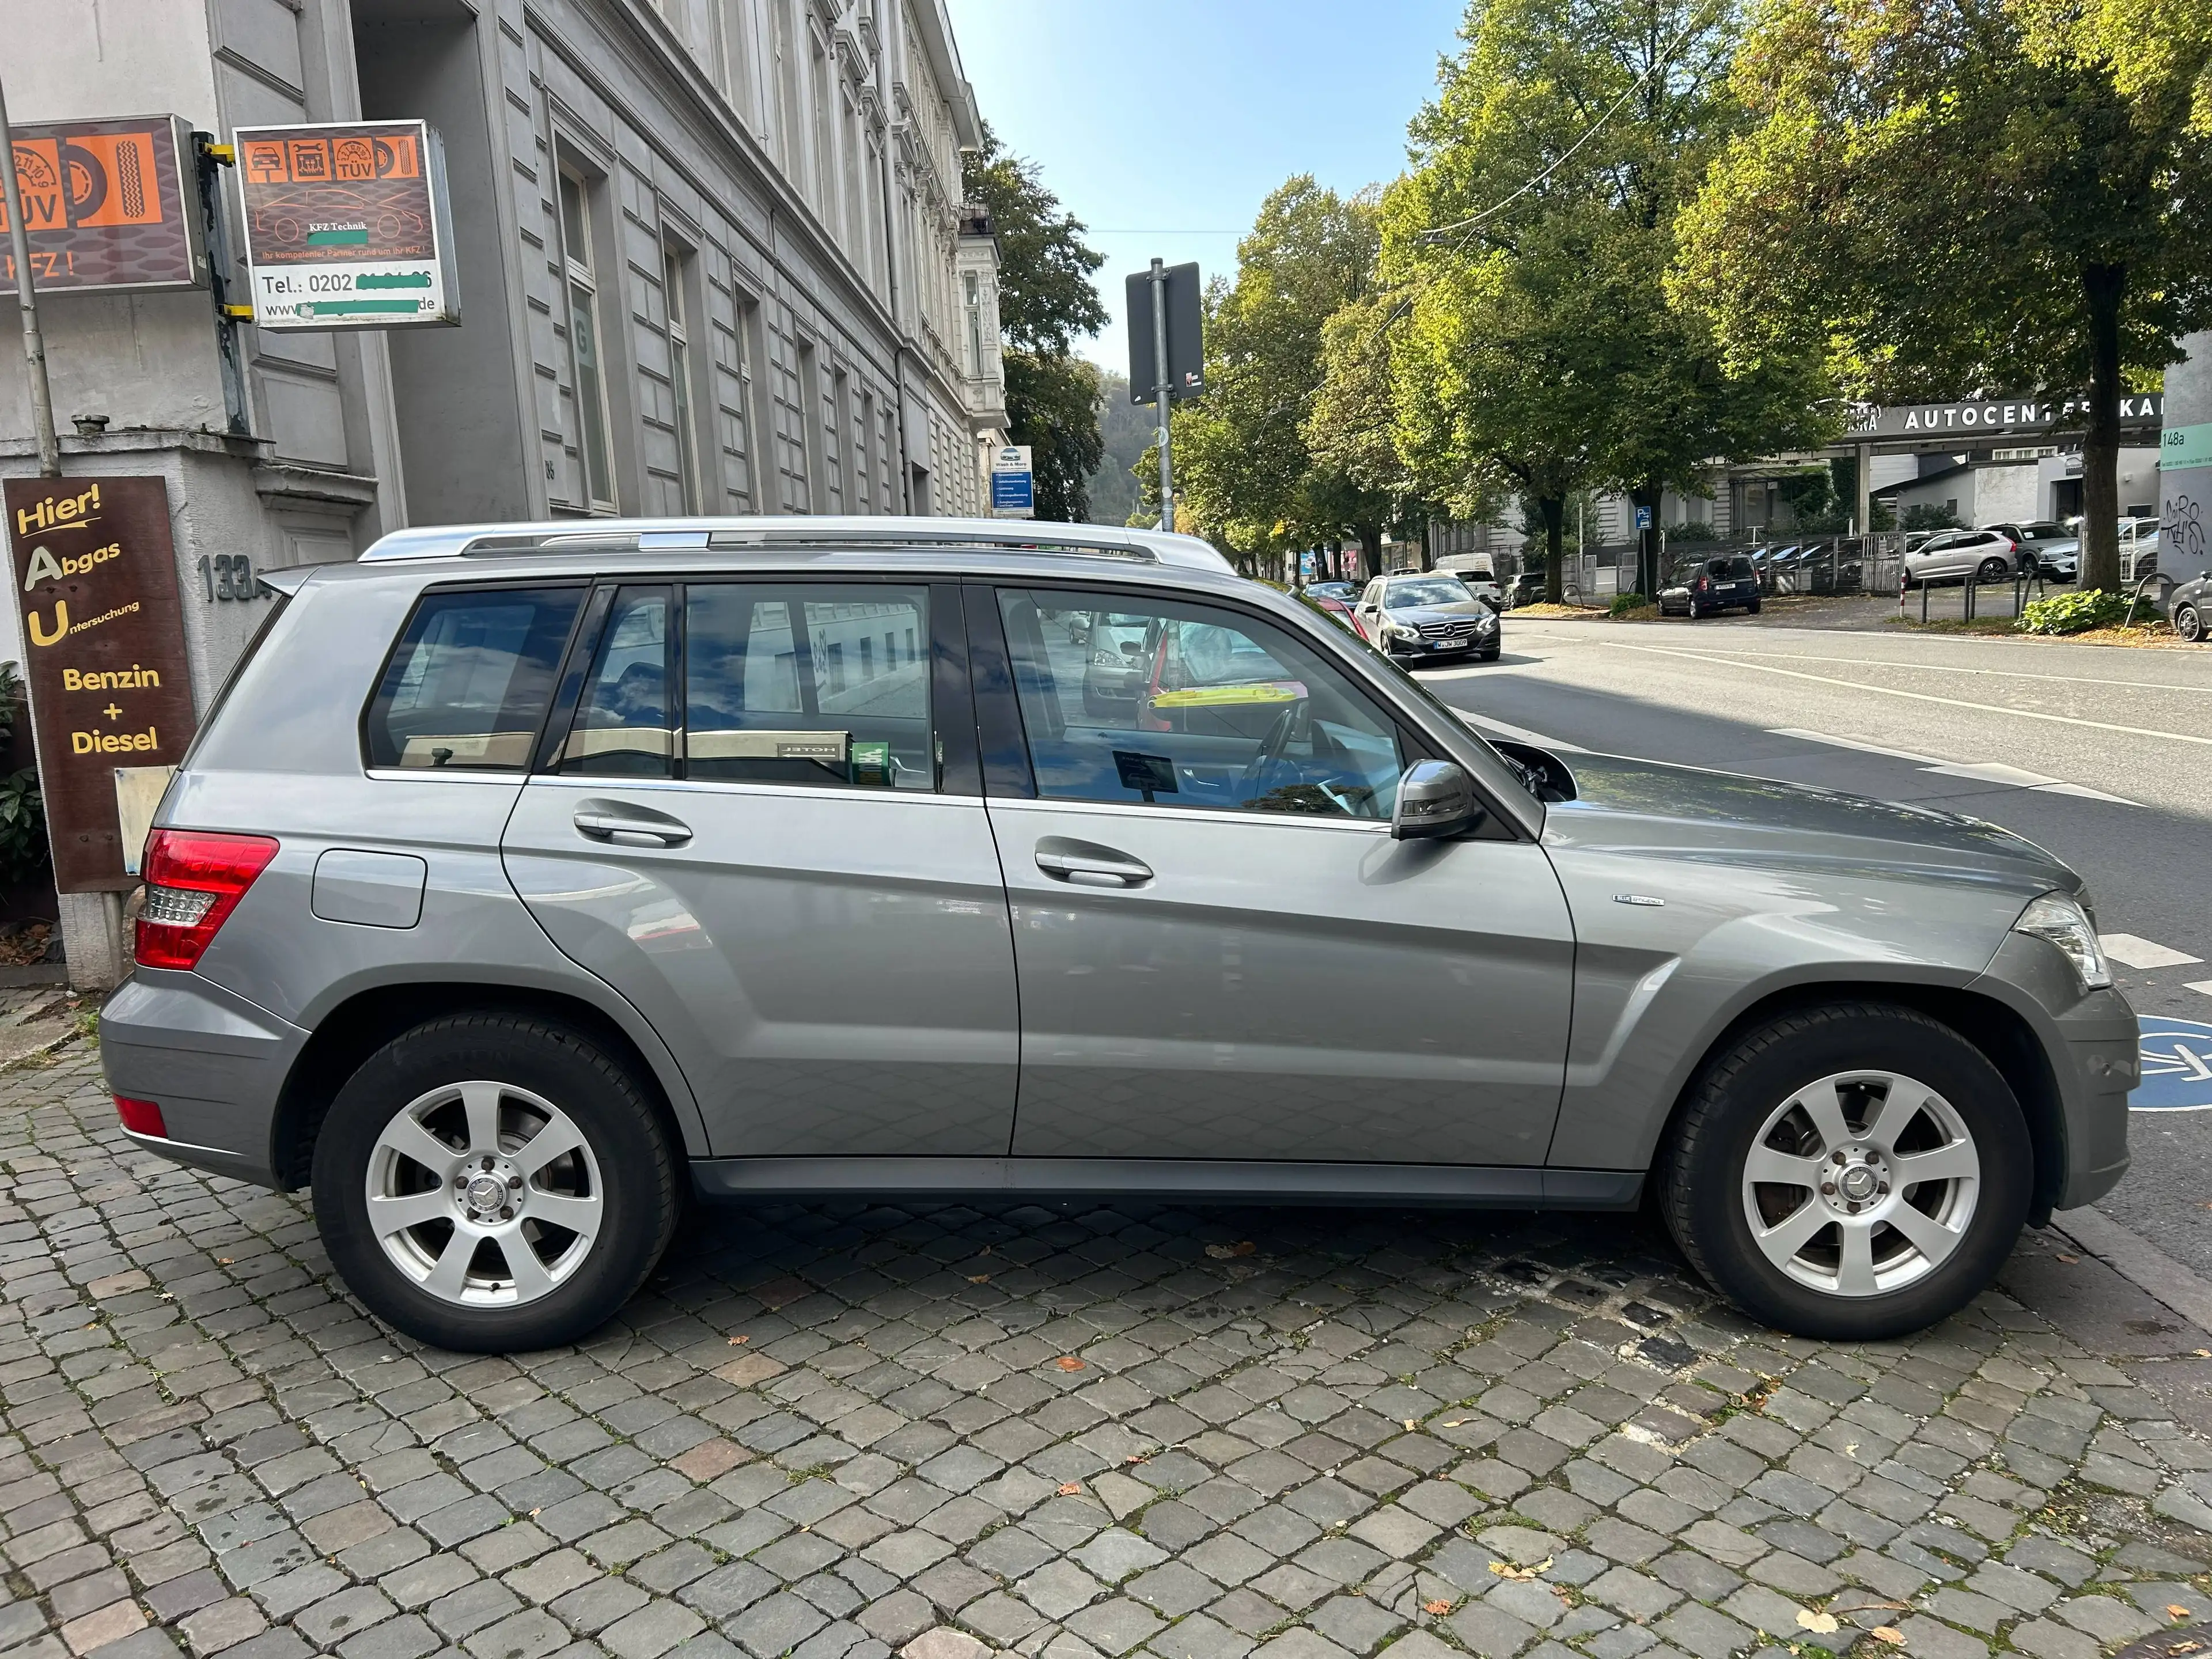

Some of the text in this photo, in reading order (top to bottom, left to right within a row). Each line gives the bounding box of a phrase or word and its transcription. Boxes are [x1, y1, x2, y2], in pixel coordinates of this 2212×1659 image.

[338, 159, 372, 177] TÜV
[309, 221, 368, 232] KFZ Technik
[358, 248, 376, 256] rund
[262, 276, 302, 294] Tel.:
[309, 274, 353, 292] 0202
[2163, 431, 2184, 447] 148a
[17, 483, 101, 535] Hier!
[25, 543, 121, 591] Abgas
[28, 600, 139, 647] Untersuchung
[63, 664, 160, 691] Benzin
[71, 726, 158, 755] Diesel
